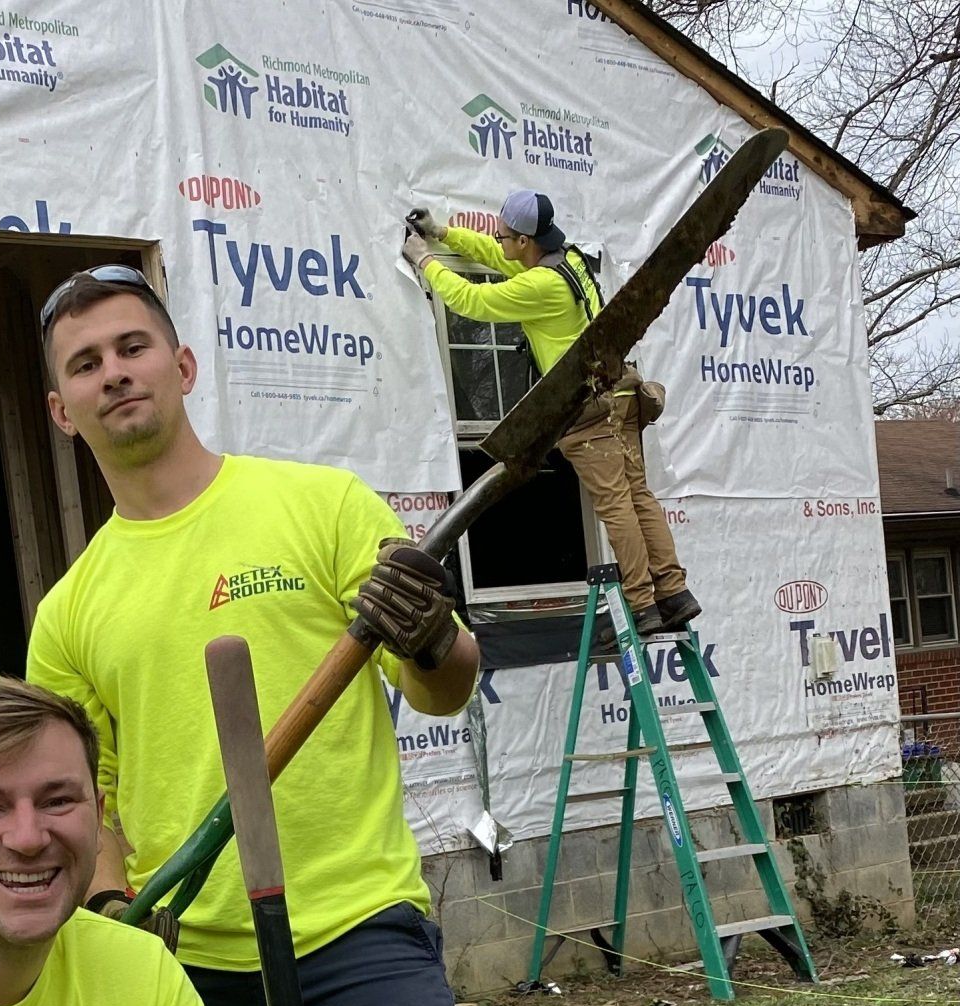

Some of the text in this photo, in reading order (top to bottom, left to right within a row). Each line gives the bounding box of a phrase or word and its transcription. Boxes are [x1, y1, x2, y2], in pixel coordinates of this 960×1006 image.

[8, 15, 79, 37] Metropolitan
[262, 55, 371, 87] Richmond Metropolitan
[265, 74, 350, 116] Habitat
[268, 106, 351, 137] for Humanity
[520, 102, 561, 121] Richmond
[523, 119, 593, 156] Habitat
[524, 149, 594, 176] for Humanity
[189, 176, 253, 210] DUPONT
[193, 219, 366, 307] Tyvek
[686, 277, 809, 347] Tyvek
[216, 315, 375, 366] HomeWrap
[701, 355, 815, 392] HomeWrap
[803, 498, 880, 519] & Sons, Inc.
[230, 577, 305, 601] ROOFING
[397, 724, 472, 753] meWra
